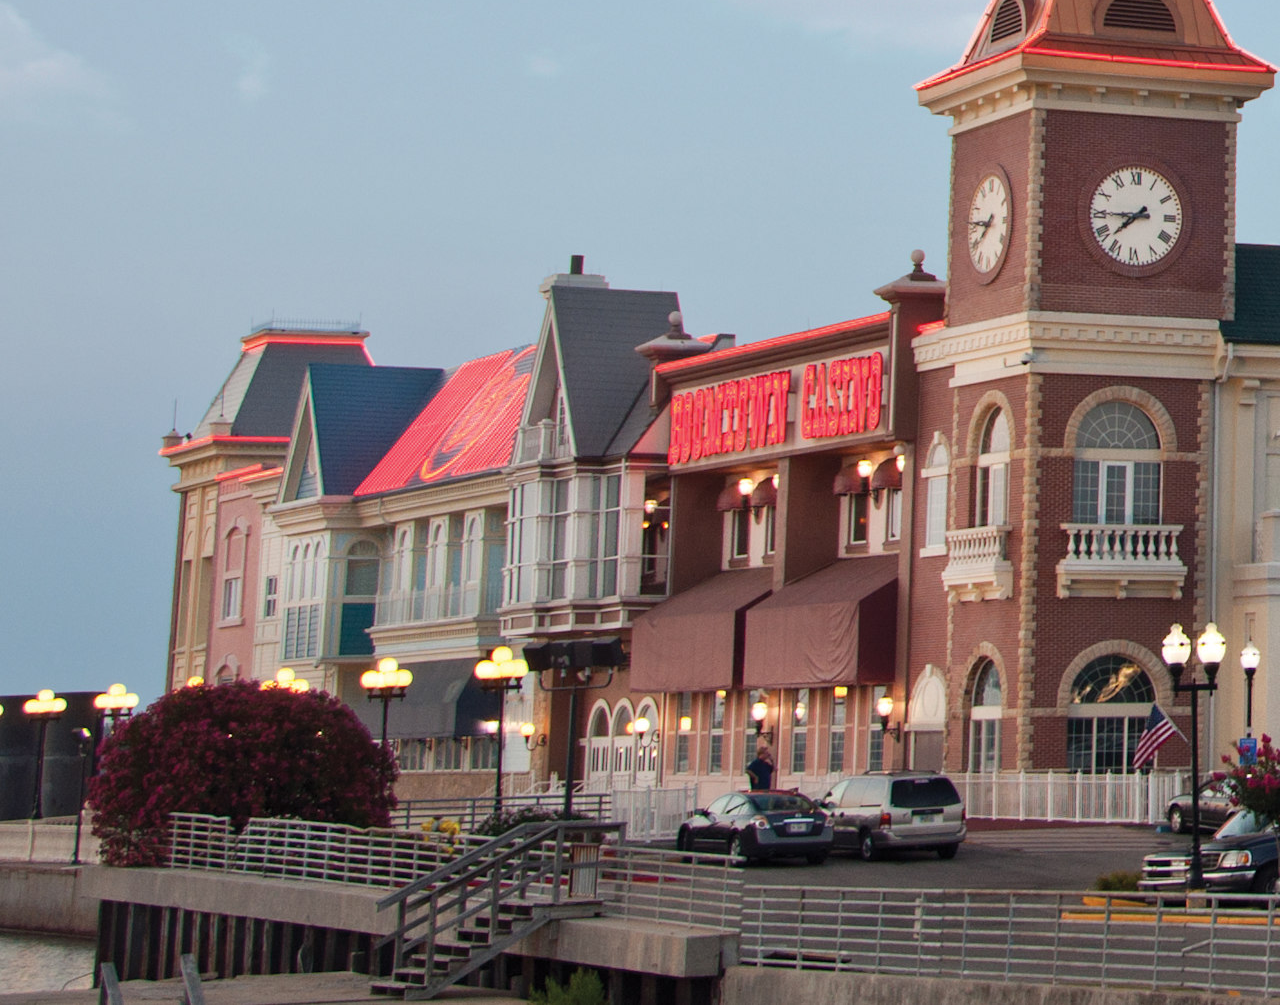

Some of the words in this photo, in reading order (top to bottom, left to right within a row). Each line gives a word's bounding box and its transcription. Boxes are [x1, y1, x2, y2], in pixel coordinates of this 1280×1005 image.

[1112, 174, 1125, 191] XI
[1130, 171, 1142, 185] XII
[1149, 178, 1158, 191] I
[1098, 188, 1112, 202] X
[1159, 194, 1172, 205] II
[1163, 214, 1177, 223] III
[1149, 244, 1158, 258] V
[667, 370, 791, 466] BOOMTOWN
[801, 351, 884, 440] CASINO
